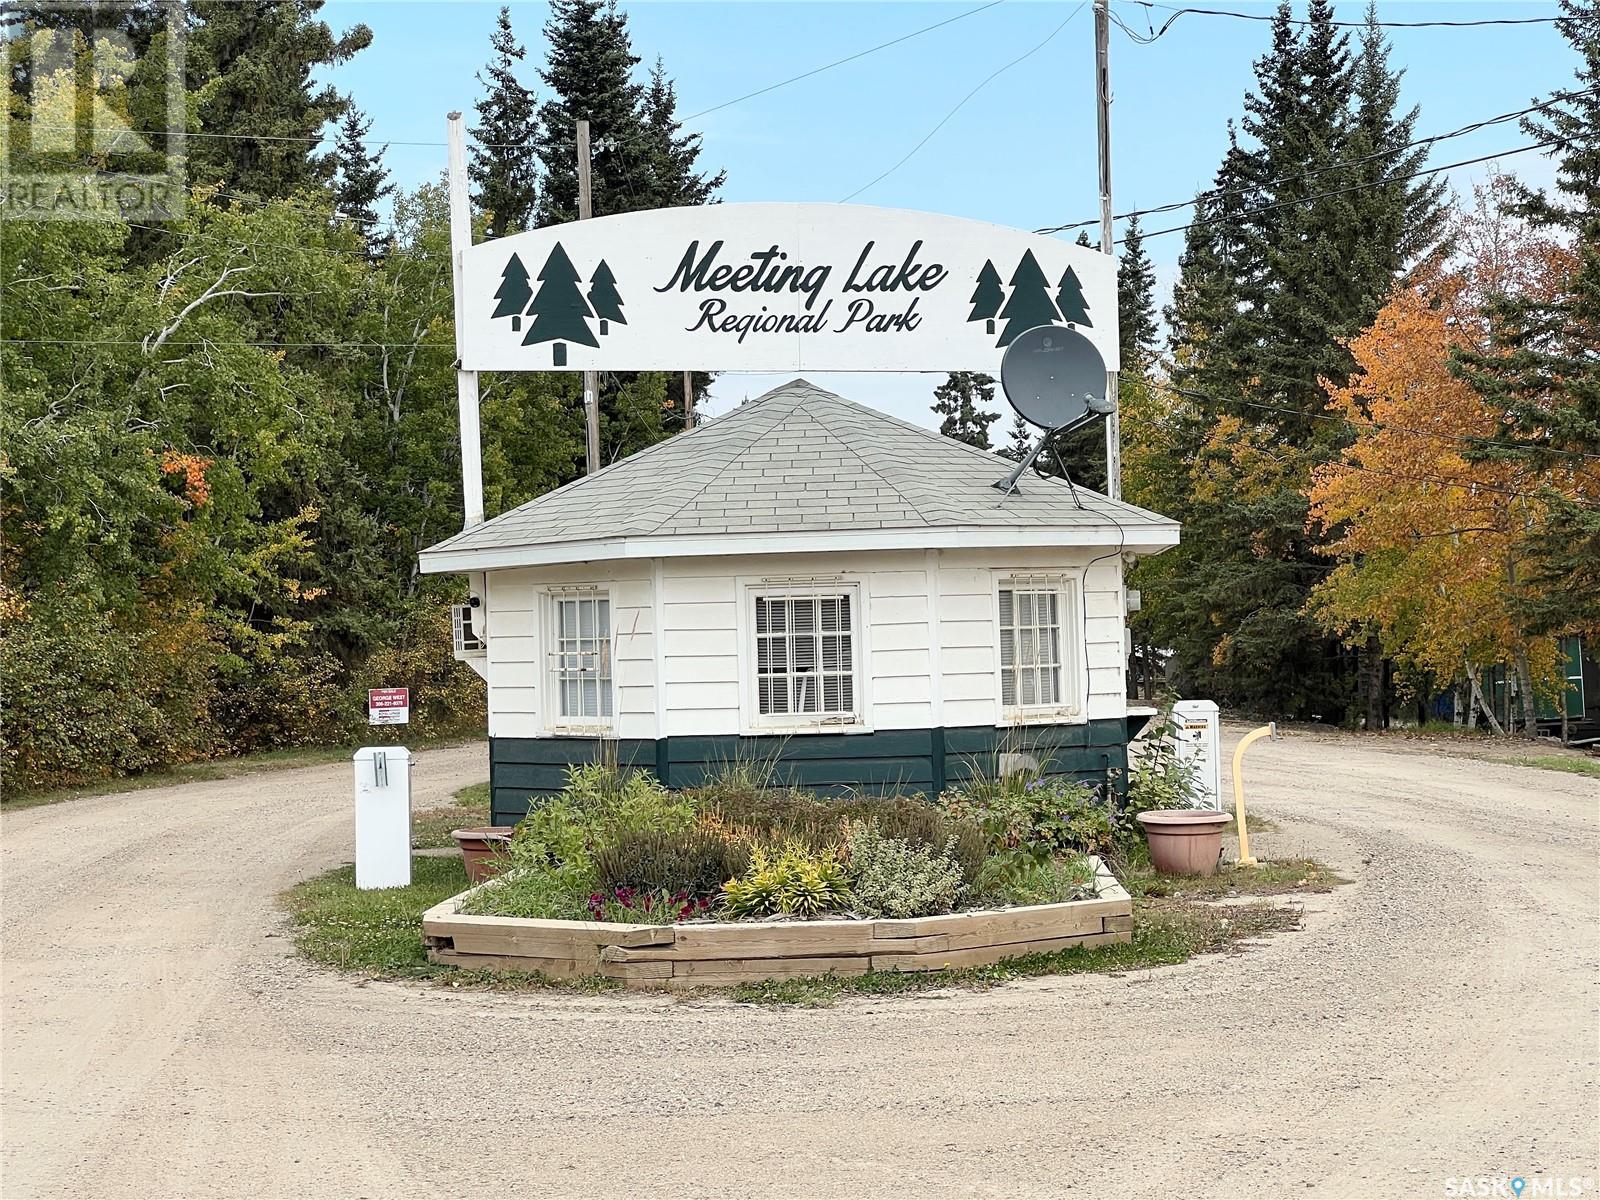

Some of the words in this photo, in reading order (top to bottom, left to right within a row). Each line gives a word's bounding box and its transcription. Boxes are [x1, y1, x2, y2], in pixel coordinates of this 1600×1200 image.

[653, 240, 833, 311] Meeting
[842, 240, 949, 292] Lake
[685, 298, 834, 344] Regional
[833, 297, 922, 333] Park
